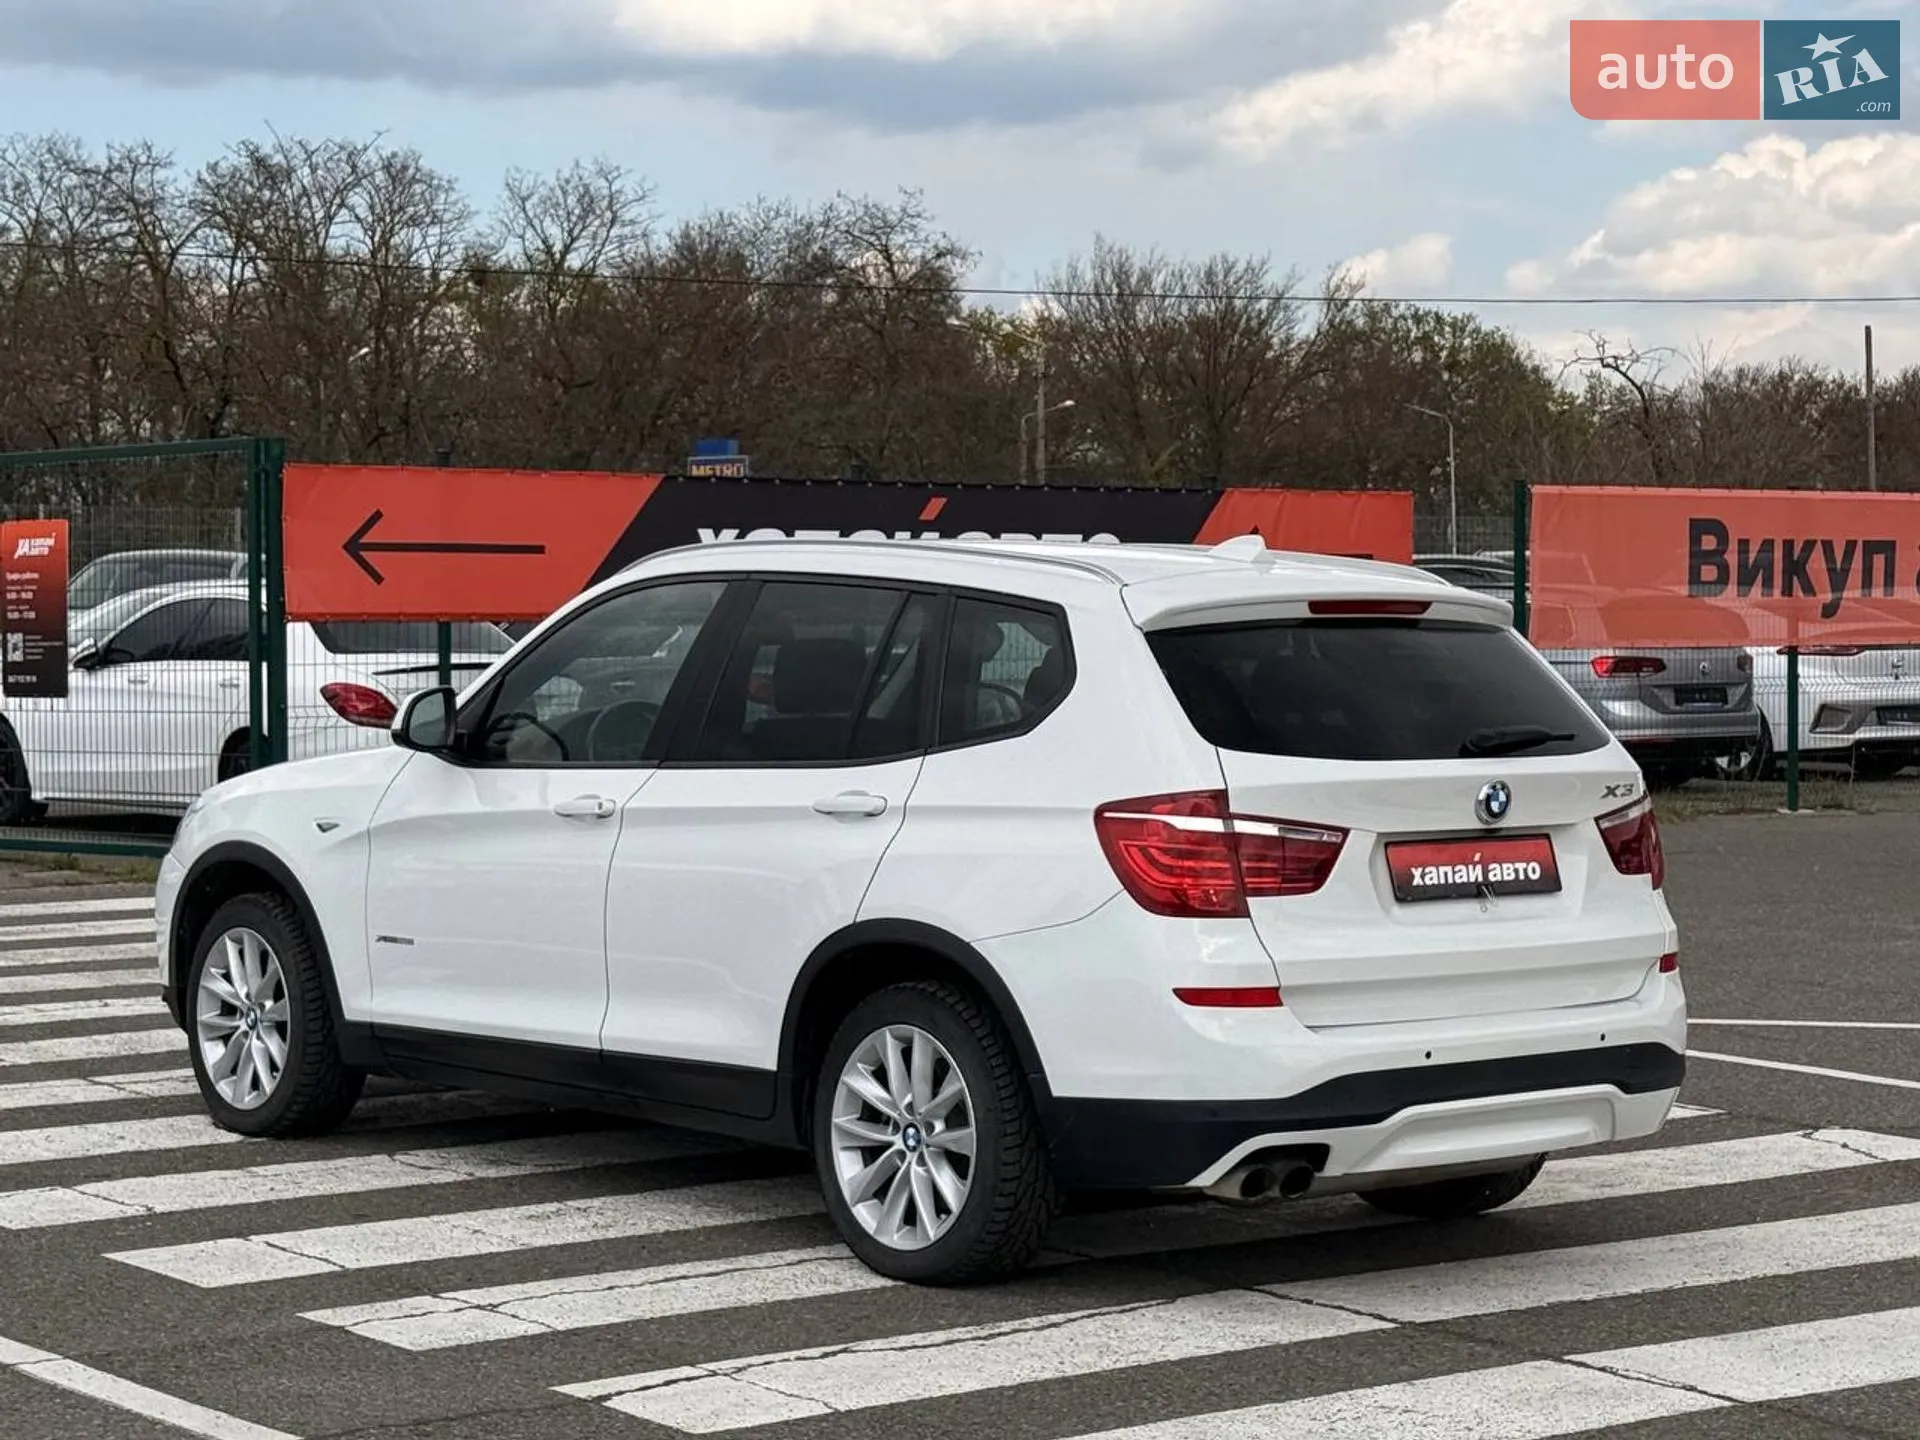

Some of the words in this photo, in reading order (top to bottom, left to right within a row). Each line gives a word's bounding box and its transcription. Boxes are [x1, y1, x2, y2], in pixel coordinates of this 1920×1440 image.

[691, 464, 744, 477] METRO
[1688, 517, 1897, 619] Викуп
[1601, 783, 1634, 799] X3
[1410, 853, 1483, 886] хапай
[1488, 860, 1541, 882] авто
